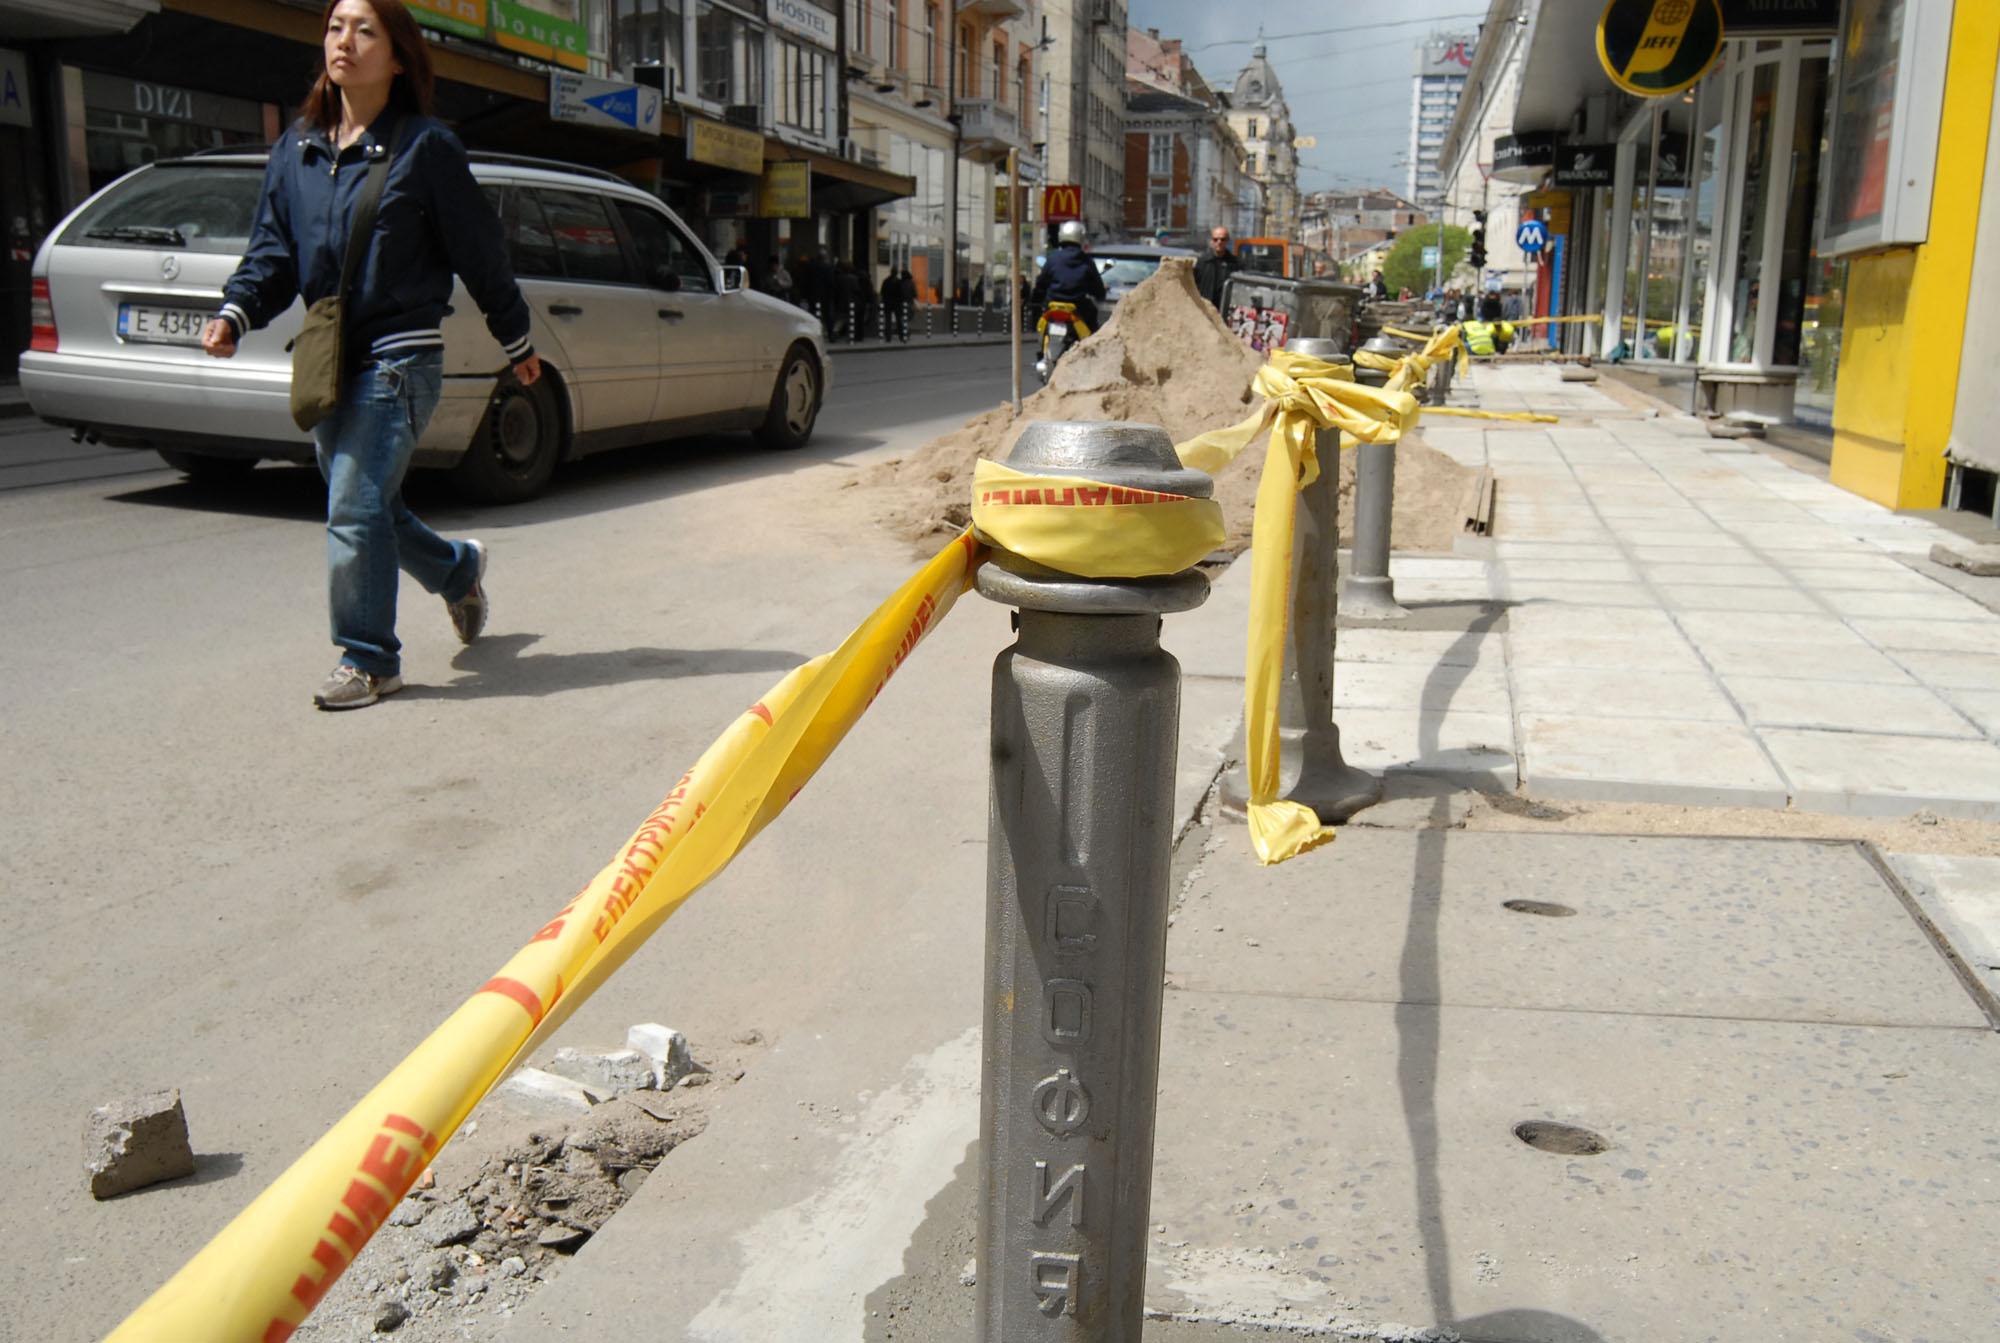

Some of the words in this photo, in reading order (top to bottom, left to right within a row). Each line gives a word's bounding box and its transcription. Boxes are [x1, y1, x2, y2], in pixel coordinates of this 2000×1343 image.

[491, 0, 577, 50] house
[775, 0, 829, 34] HOSTEL
[1640, 35, 1679, 49] JEFF
[134, 82, 192, 119] DIZI
[1030, 884, 1098, 1317] СОФИЯ
